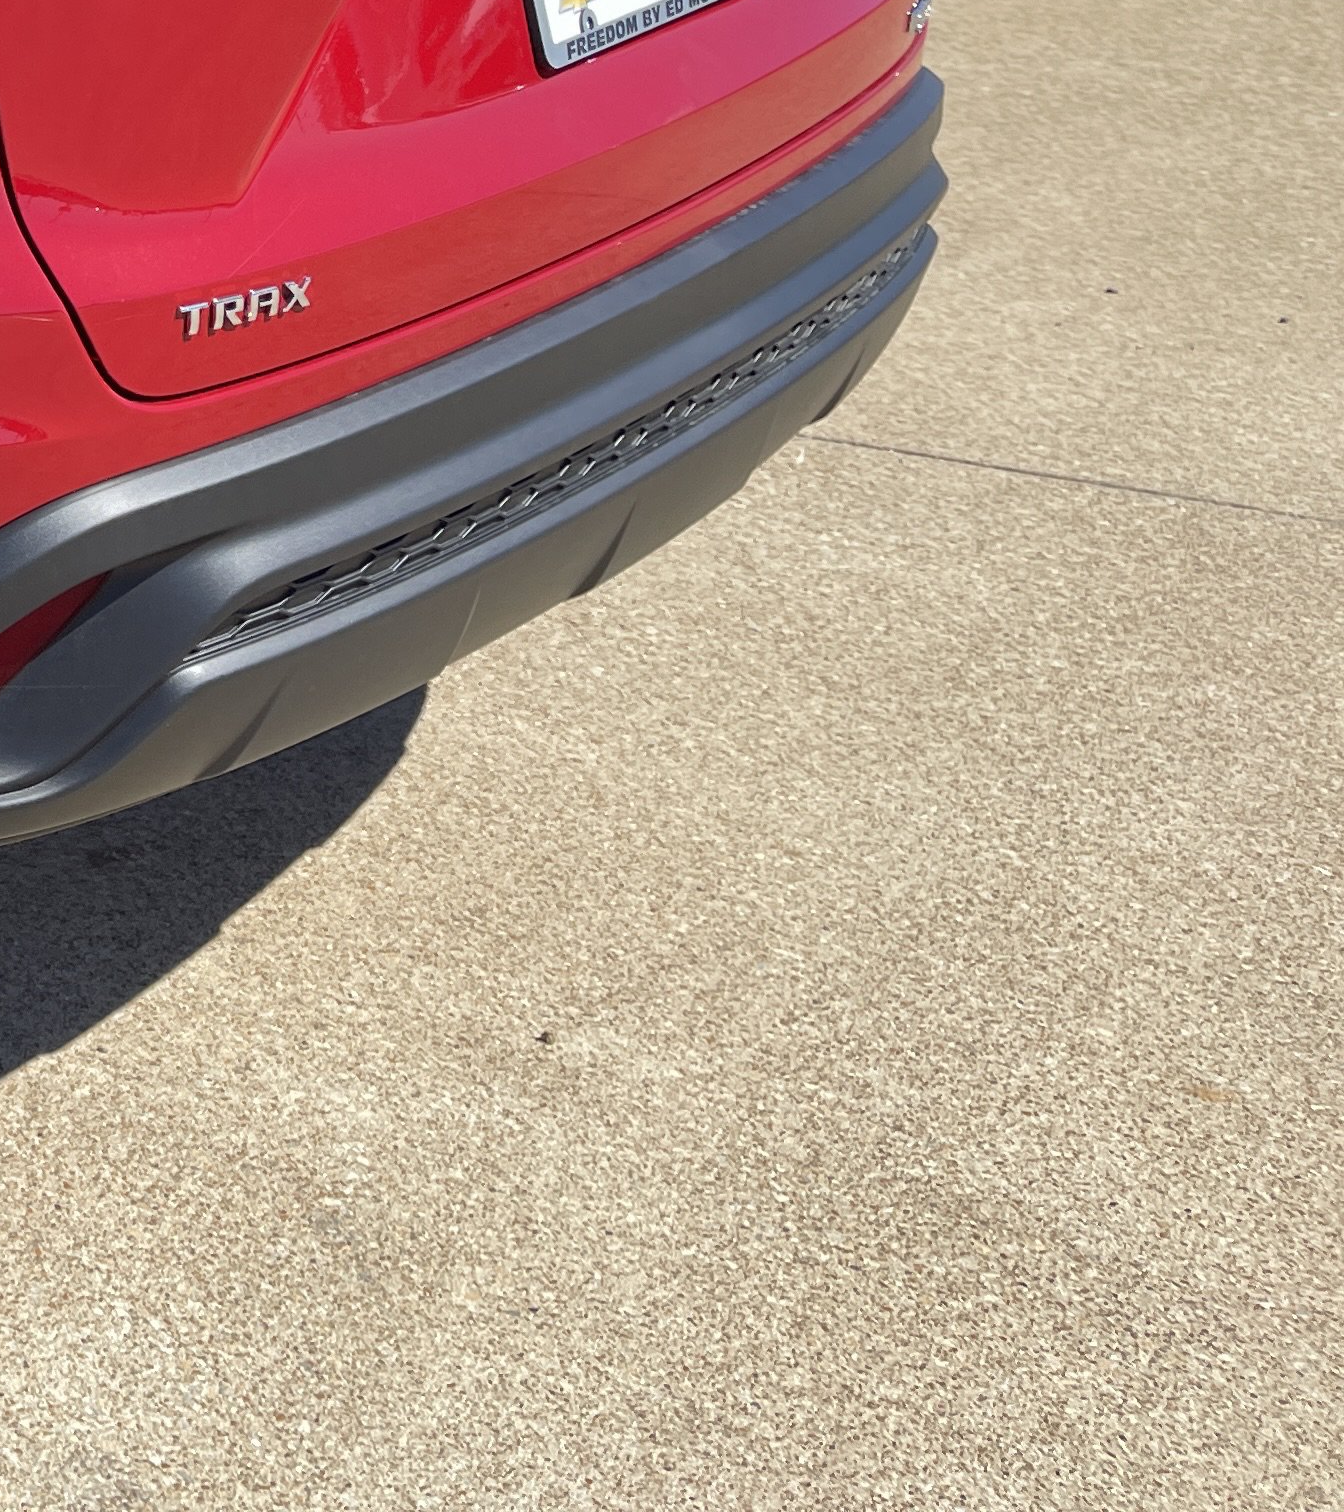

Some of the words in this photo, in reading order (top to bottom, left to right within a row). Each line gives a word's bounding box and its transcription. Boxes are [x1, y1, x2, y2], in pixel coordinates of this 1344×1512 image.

[566, 15, 638, 60] FREEDOM
[642, 5, 661, 27] BY
[177, 276, 311, 336] TRAX
